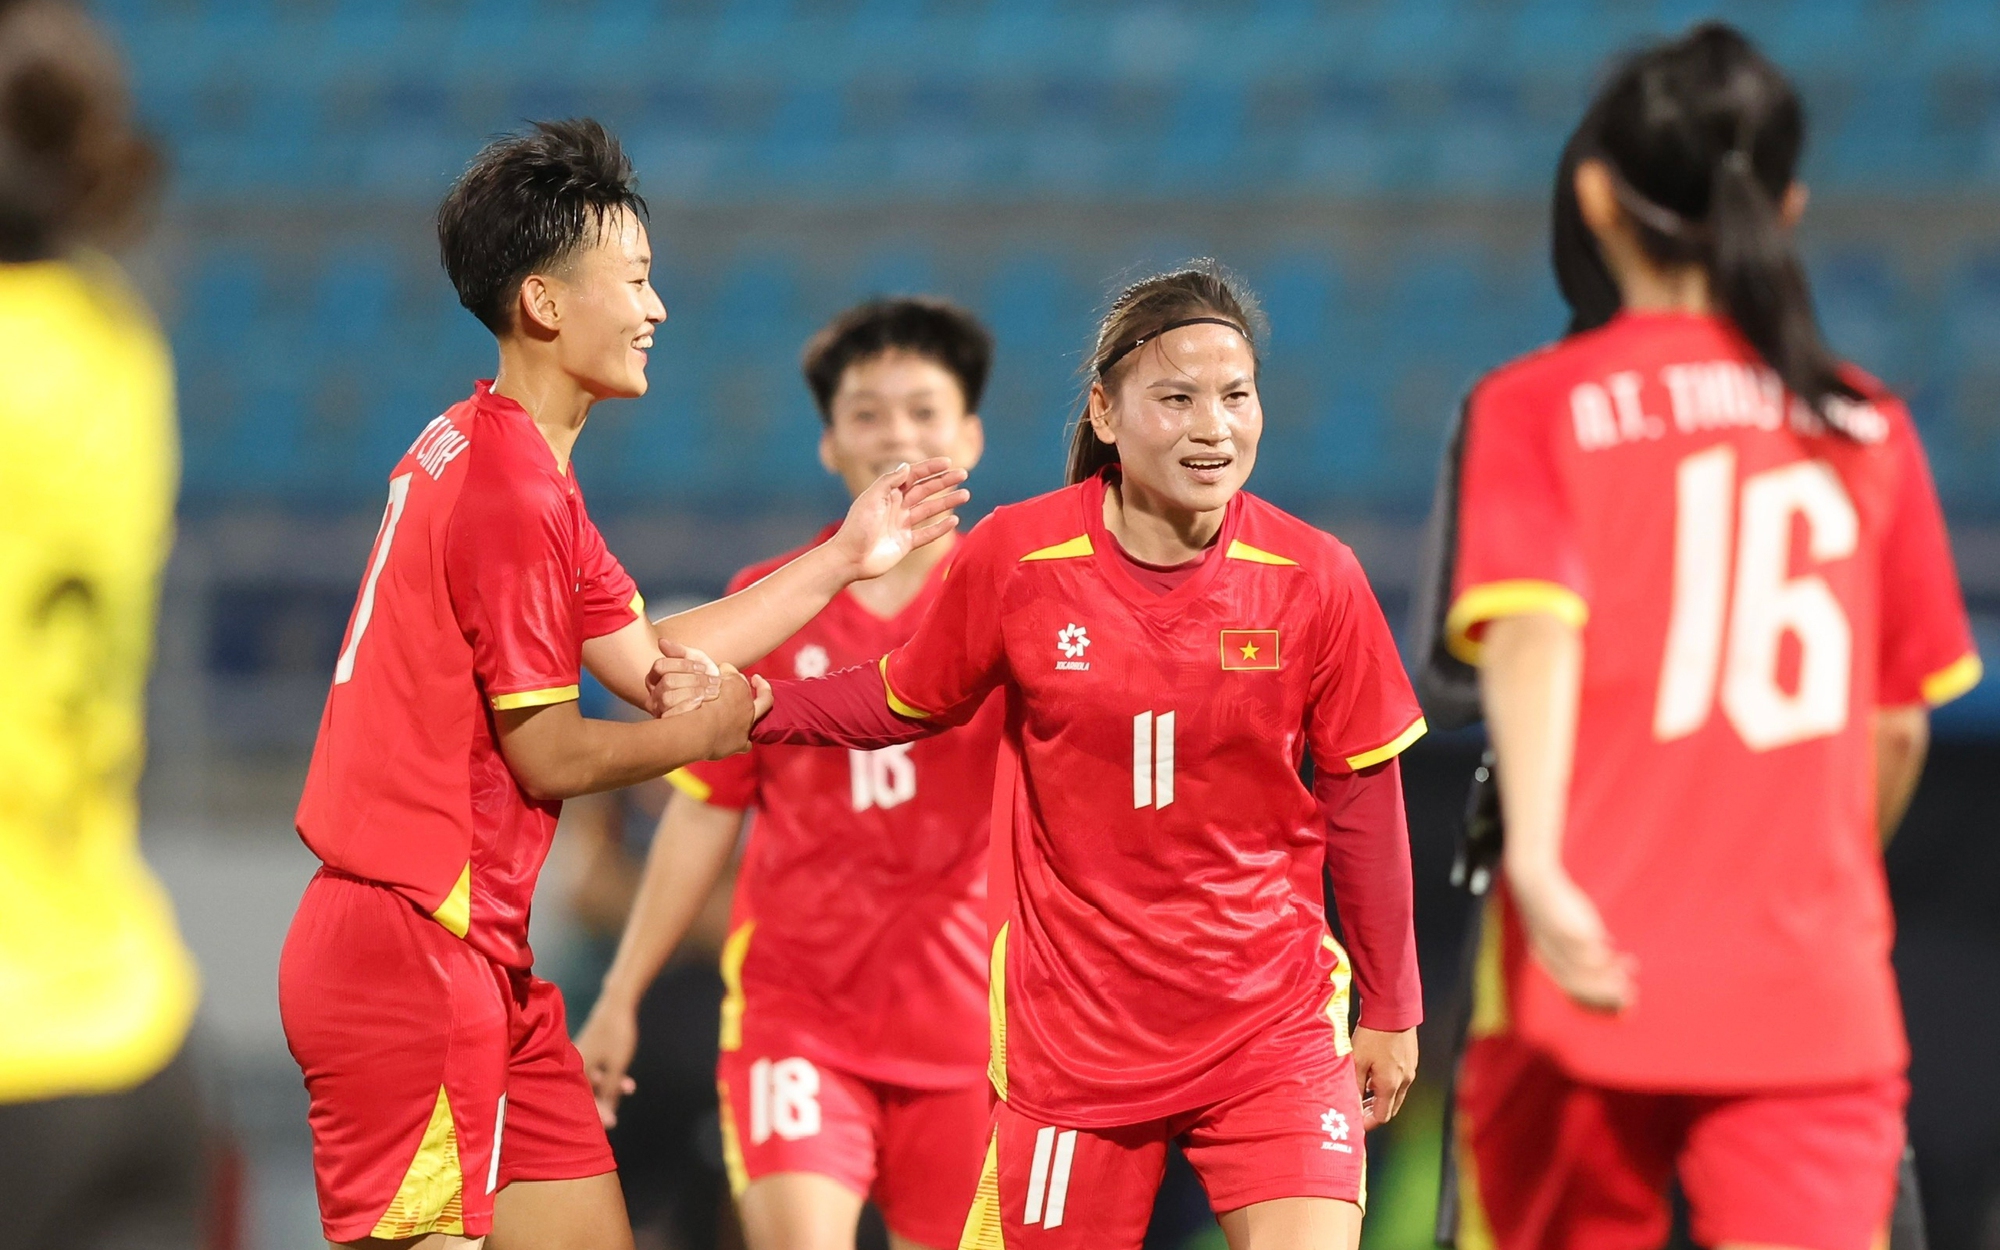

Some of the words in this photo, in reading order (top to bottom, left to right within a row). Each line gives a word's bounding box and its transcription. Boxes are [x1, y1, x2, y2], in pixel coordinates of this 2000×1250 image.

[1652, 443, 1860, 753] 16
[1133, 709, 1176, 811] 11
[749, 1056, 822, 1147] 18
[1022, 1125, 1078, 1230] 11
